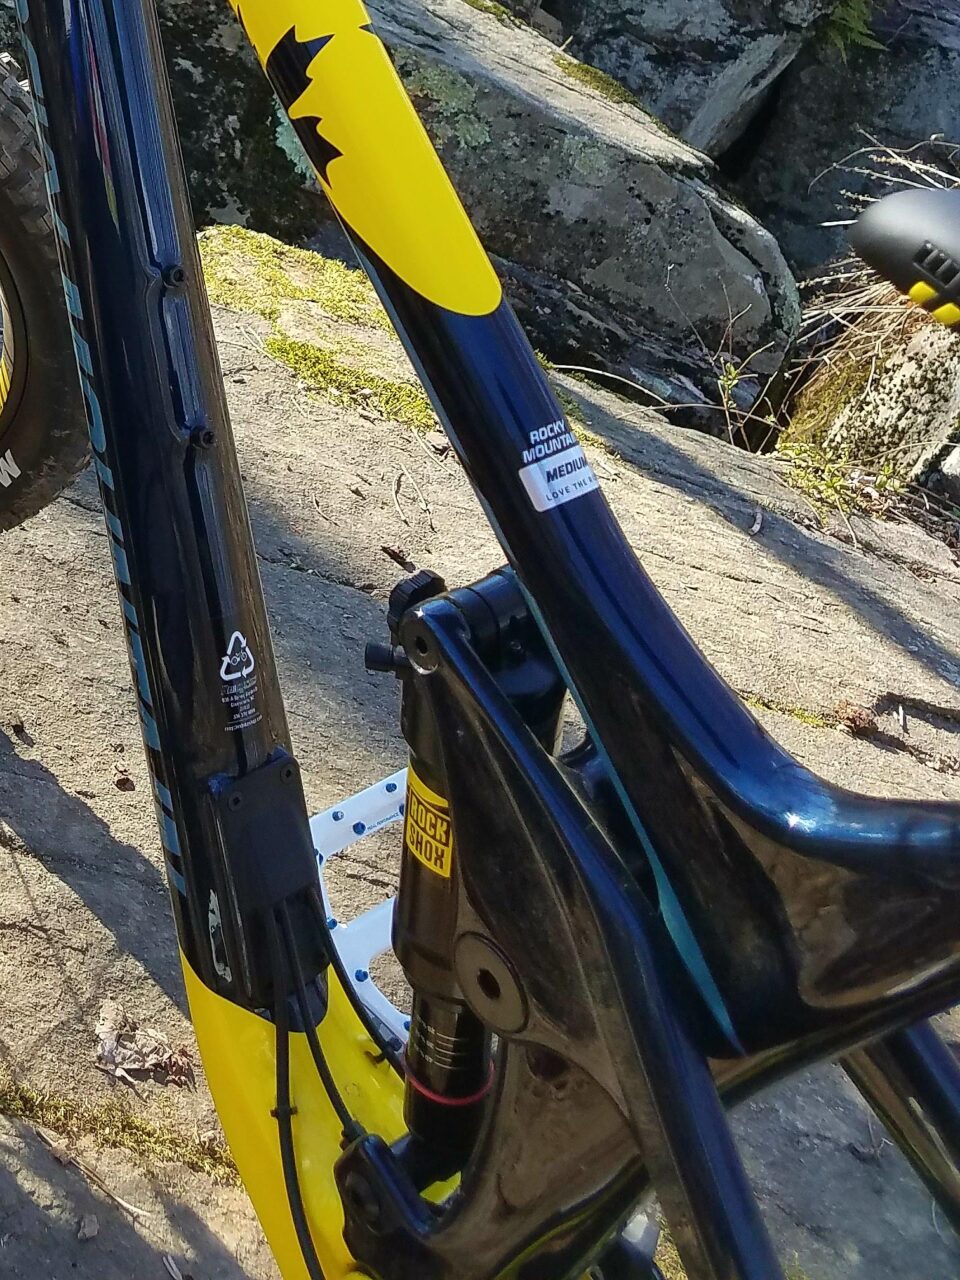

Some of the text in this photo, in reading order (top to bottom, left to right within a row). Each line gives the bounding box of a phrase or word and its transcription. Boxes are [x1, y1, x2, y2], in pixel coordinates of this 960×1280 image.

[522, 431, 576, 464] MOUNTAI
[529, 419, 566, 445] ROCKY
[545, 486, 571, 501] LOVE
[572, 479, 588, 490] THE
[410, 792, 448, 844] ROCK
[408, 821, 446, 870] SHOX
